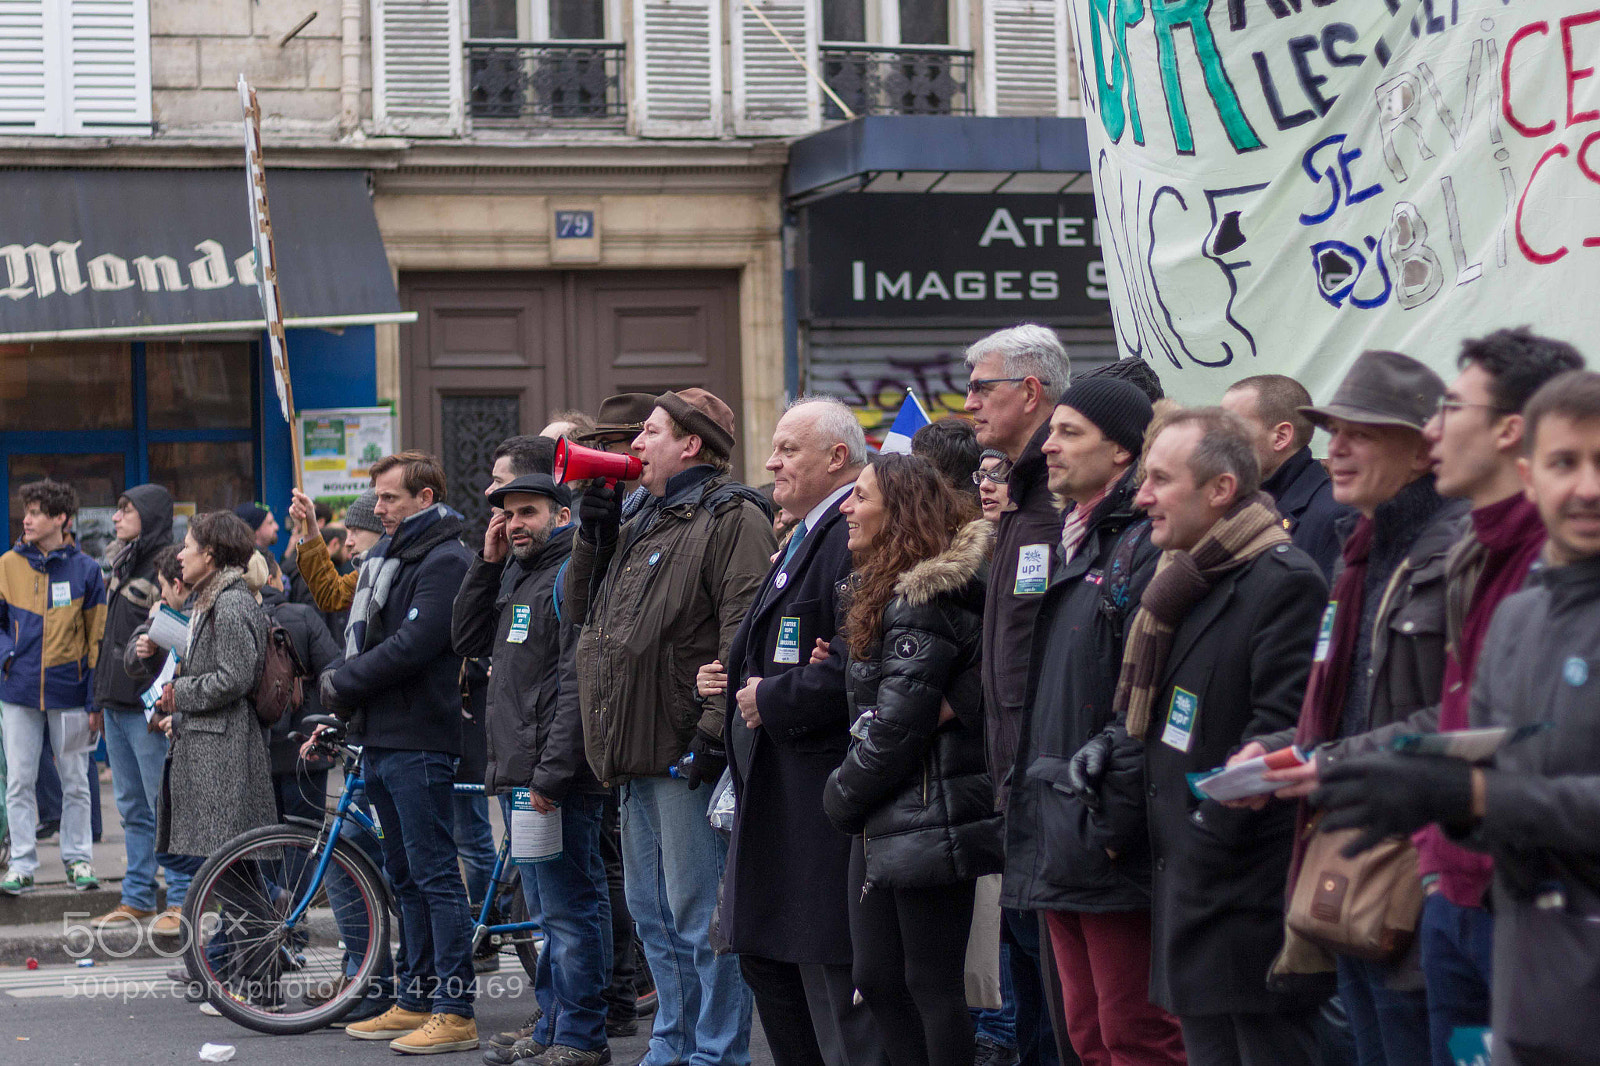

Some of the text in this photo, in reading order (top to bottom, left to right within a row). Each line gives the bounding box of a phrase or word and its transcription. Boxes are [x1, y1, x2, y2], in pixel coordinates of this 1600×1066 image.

[1252, 22, 1367, 131] LES
[561, 214, 588, 236] 79
[853, 261, 1059, 301] IMAGES
[323, 481, 371, 492] NOUVEA
[1022, 564, 1042, 575] upr
